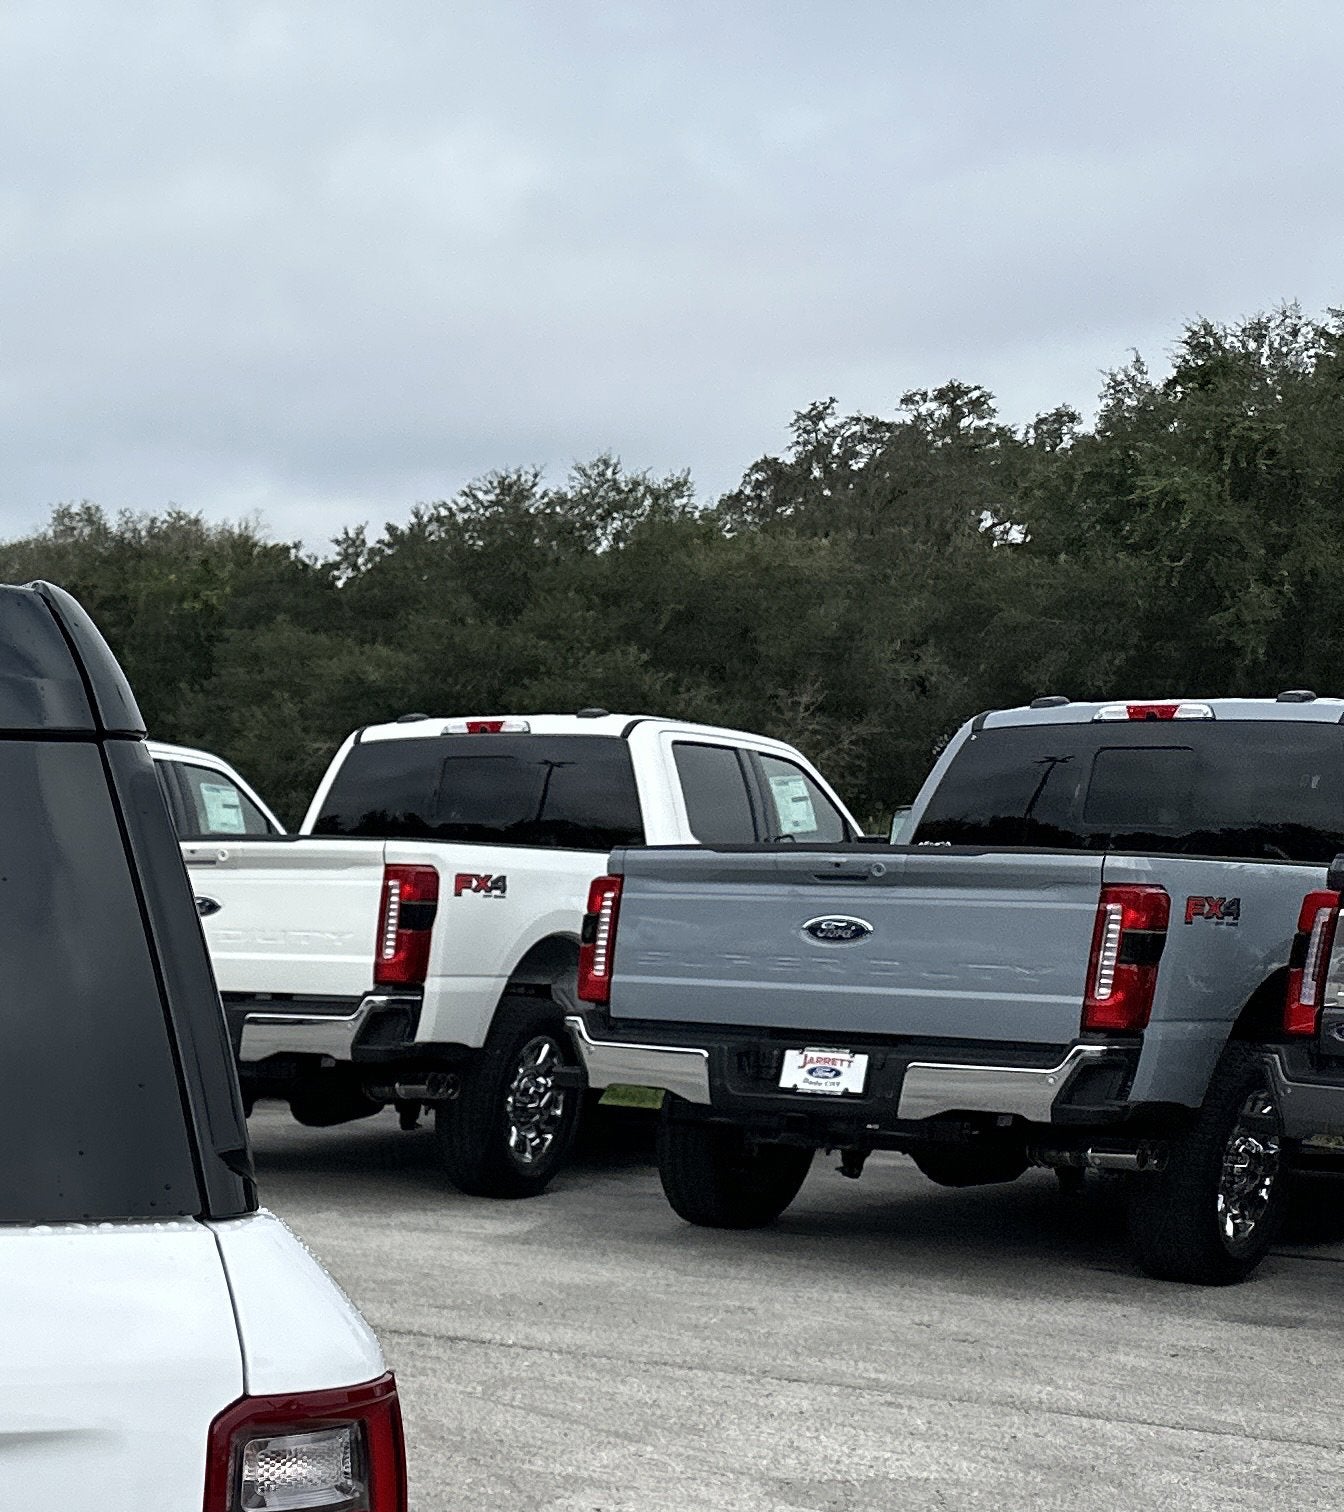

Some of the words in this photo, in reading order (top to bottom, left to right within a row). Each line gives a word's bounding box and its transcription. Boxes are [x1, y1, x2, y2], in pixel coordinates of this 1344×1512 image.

[454, 873, 507, 896] FX4
[1185, 896, 1241, 925] FX4
[817, 921, 855, 938] Ford
[798, 1054, 854, 1069] JARRETT
